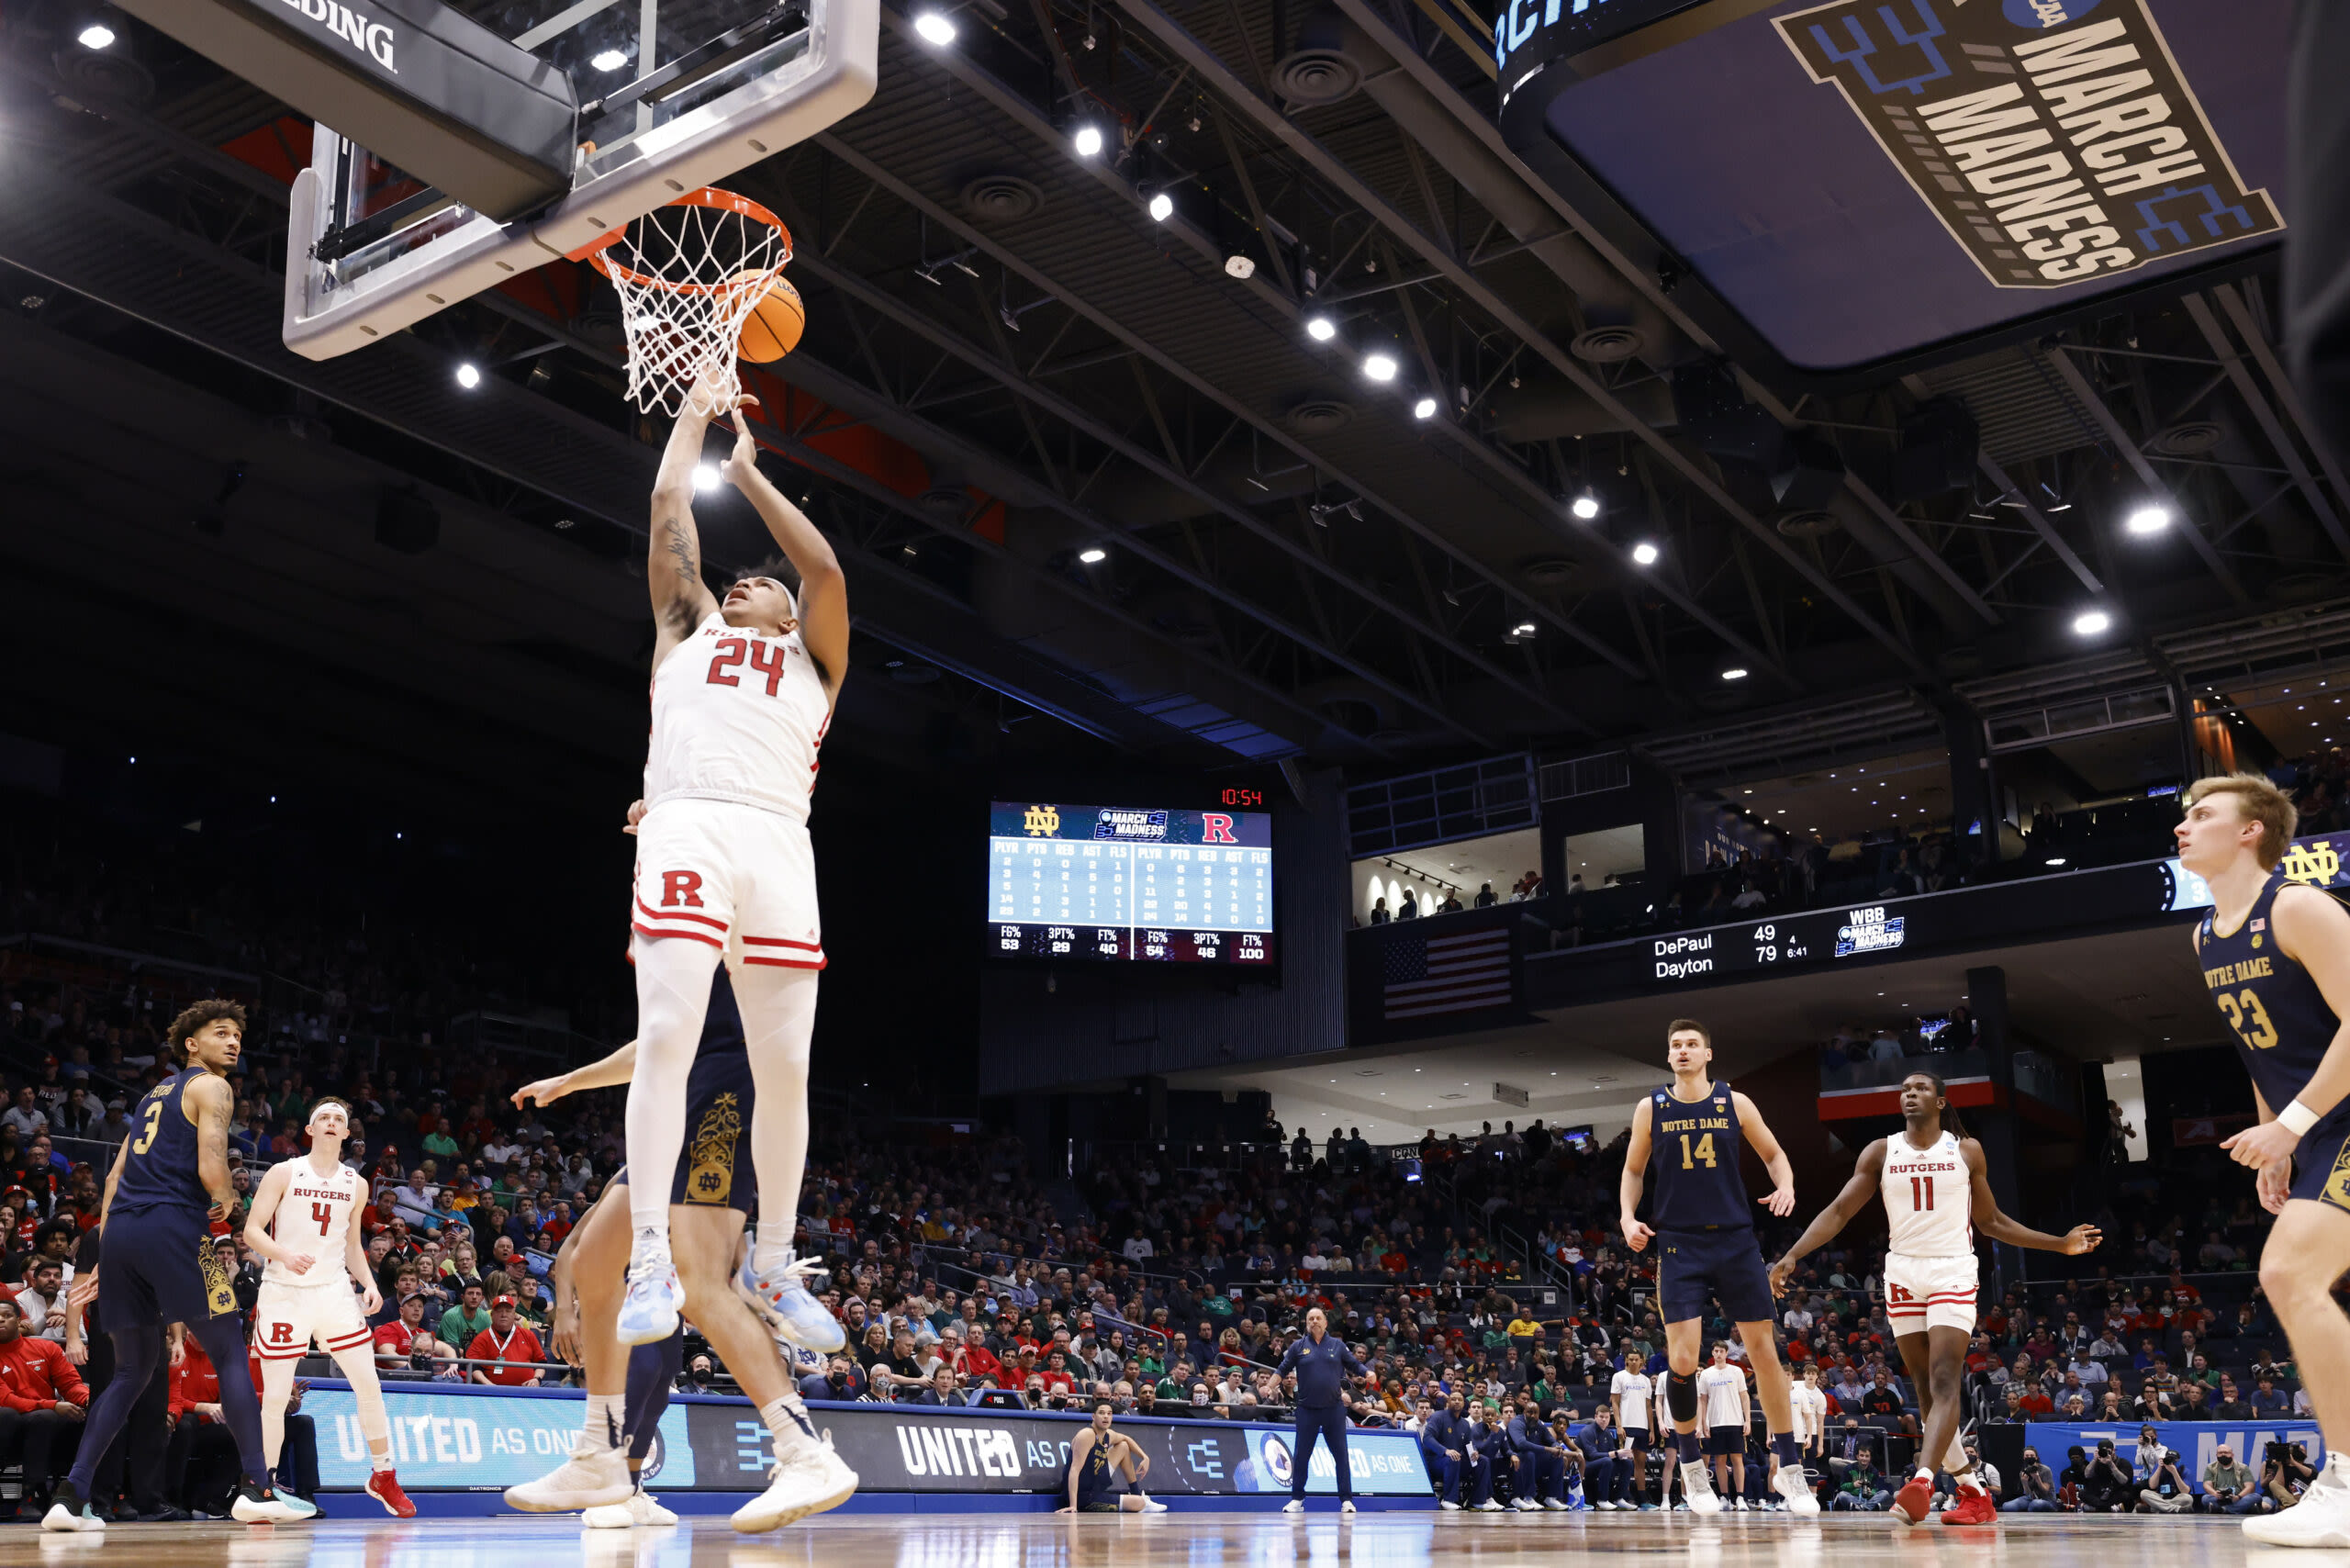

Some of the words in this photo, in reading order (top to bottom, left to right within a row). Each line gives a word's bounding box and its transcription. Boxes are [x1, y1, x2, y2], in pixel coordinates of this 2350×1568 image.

[2012, 17, 2206, 196] MARCH
[1916, 82, 2135, 280] MADNESS
[706, 638, 785, 698] 24
[1222, 789, 1262, 806] 10:54
[1112, 812, 1147, 824] MARCH
[1114, 823, 1164, 836] MADNESS
[1203, 813, 1235, 843] R
[995, 842, 1019, 854] PLYR
[1027, 843, 1046, 855] PTS
[1057, 845, 1074, 856] REB
[1083, 846, 1102, 857] AST
[1110, 846, 1127, 857] FLS
[1115, 861, 1122, 870] 1
[660, 869, 704, 907] R
[1033, 883, 1041, 891] 7
[1062, 884, 1069, 892] 1
[1257, 880, 1263, 889] 1
[1090, 898, 1096, 906] 1
[1115, 899, 1122, 908] 1
[1231, 890, 1237, 900] 1
[1090, 910, 1096, 918] 1
[1115, 911, 1122, 920] 1
[1257, 904, 1263, 913] 1
[1850, 907, 1886, 925] WBB
[1001, 925, 1021, 938] FG%
[1048, 927, 1076, 940] 3PT%
[1098, 929, 1117, 941] FT%
[1147, 931, 1168, 943] FG%
[1193, 933, 1220, 945] 3PT%
[1243, 935, 1262, 946] FT%
[1851, 924, 1885, 938] MARCH
[1855, 931, 1902, 949] MADNESS
[1099, 944, 1118, 955] 40
[1654, 934, 1712, 957] DePaul
[1754, 924, 1775, 942] 49
[1789, 935, 1796, 945] 4
[1147, 945, 1165, 957] 54
[1197, 946, 1216, 958] 46
[1239, 947, 1264, 959] 100
[1655, 957, 1713, 979] Dayton
[1755, 946, 1777, 963] 79
[1786, 946, 1807, 958] 6:41
[2234, 957, 2274, 981] DAME
[2218, 988, 2278, 1050] 23
[132, 1101, 162, 1154] 3
[1662, 1119, 1696, 1133] NOTRE
[1699, 1117, 1729, 1129] DAME
[1680, 1133, 1717, 1170] 14
[1889, 1162, 1955, 1173] RUTGERS
[294, 1188, 351, 1202] RUTGERS
[1910, 1176, 1934, 1211] 11
[312, 1202, 331, 1237] 4
[1889, 1283, 1914, 1303] R
[270, 1323, 293, 1343] R
[335, 1415, 483, 1463] UITED
[492, 1428, 527, 1455] AS
[896, 1426, 1023, 1477] UNITED
[1026, 1440, 1057, 1468] AS
[1371, 1454, 1389, 1473] AS
[1388, 1455, 1415, 1474] ONE
